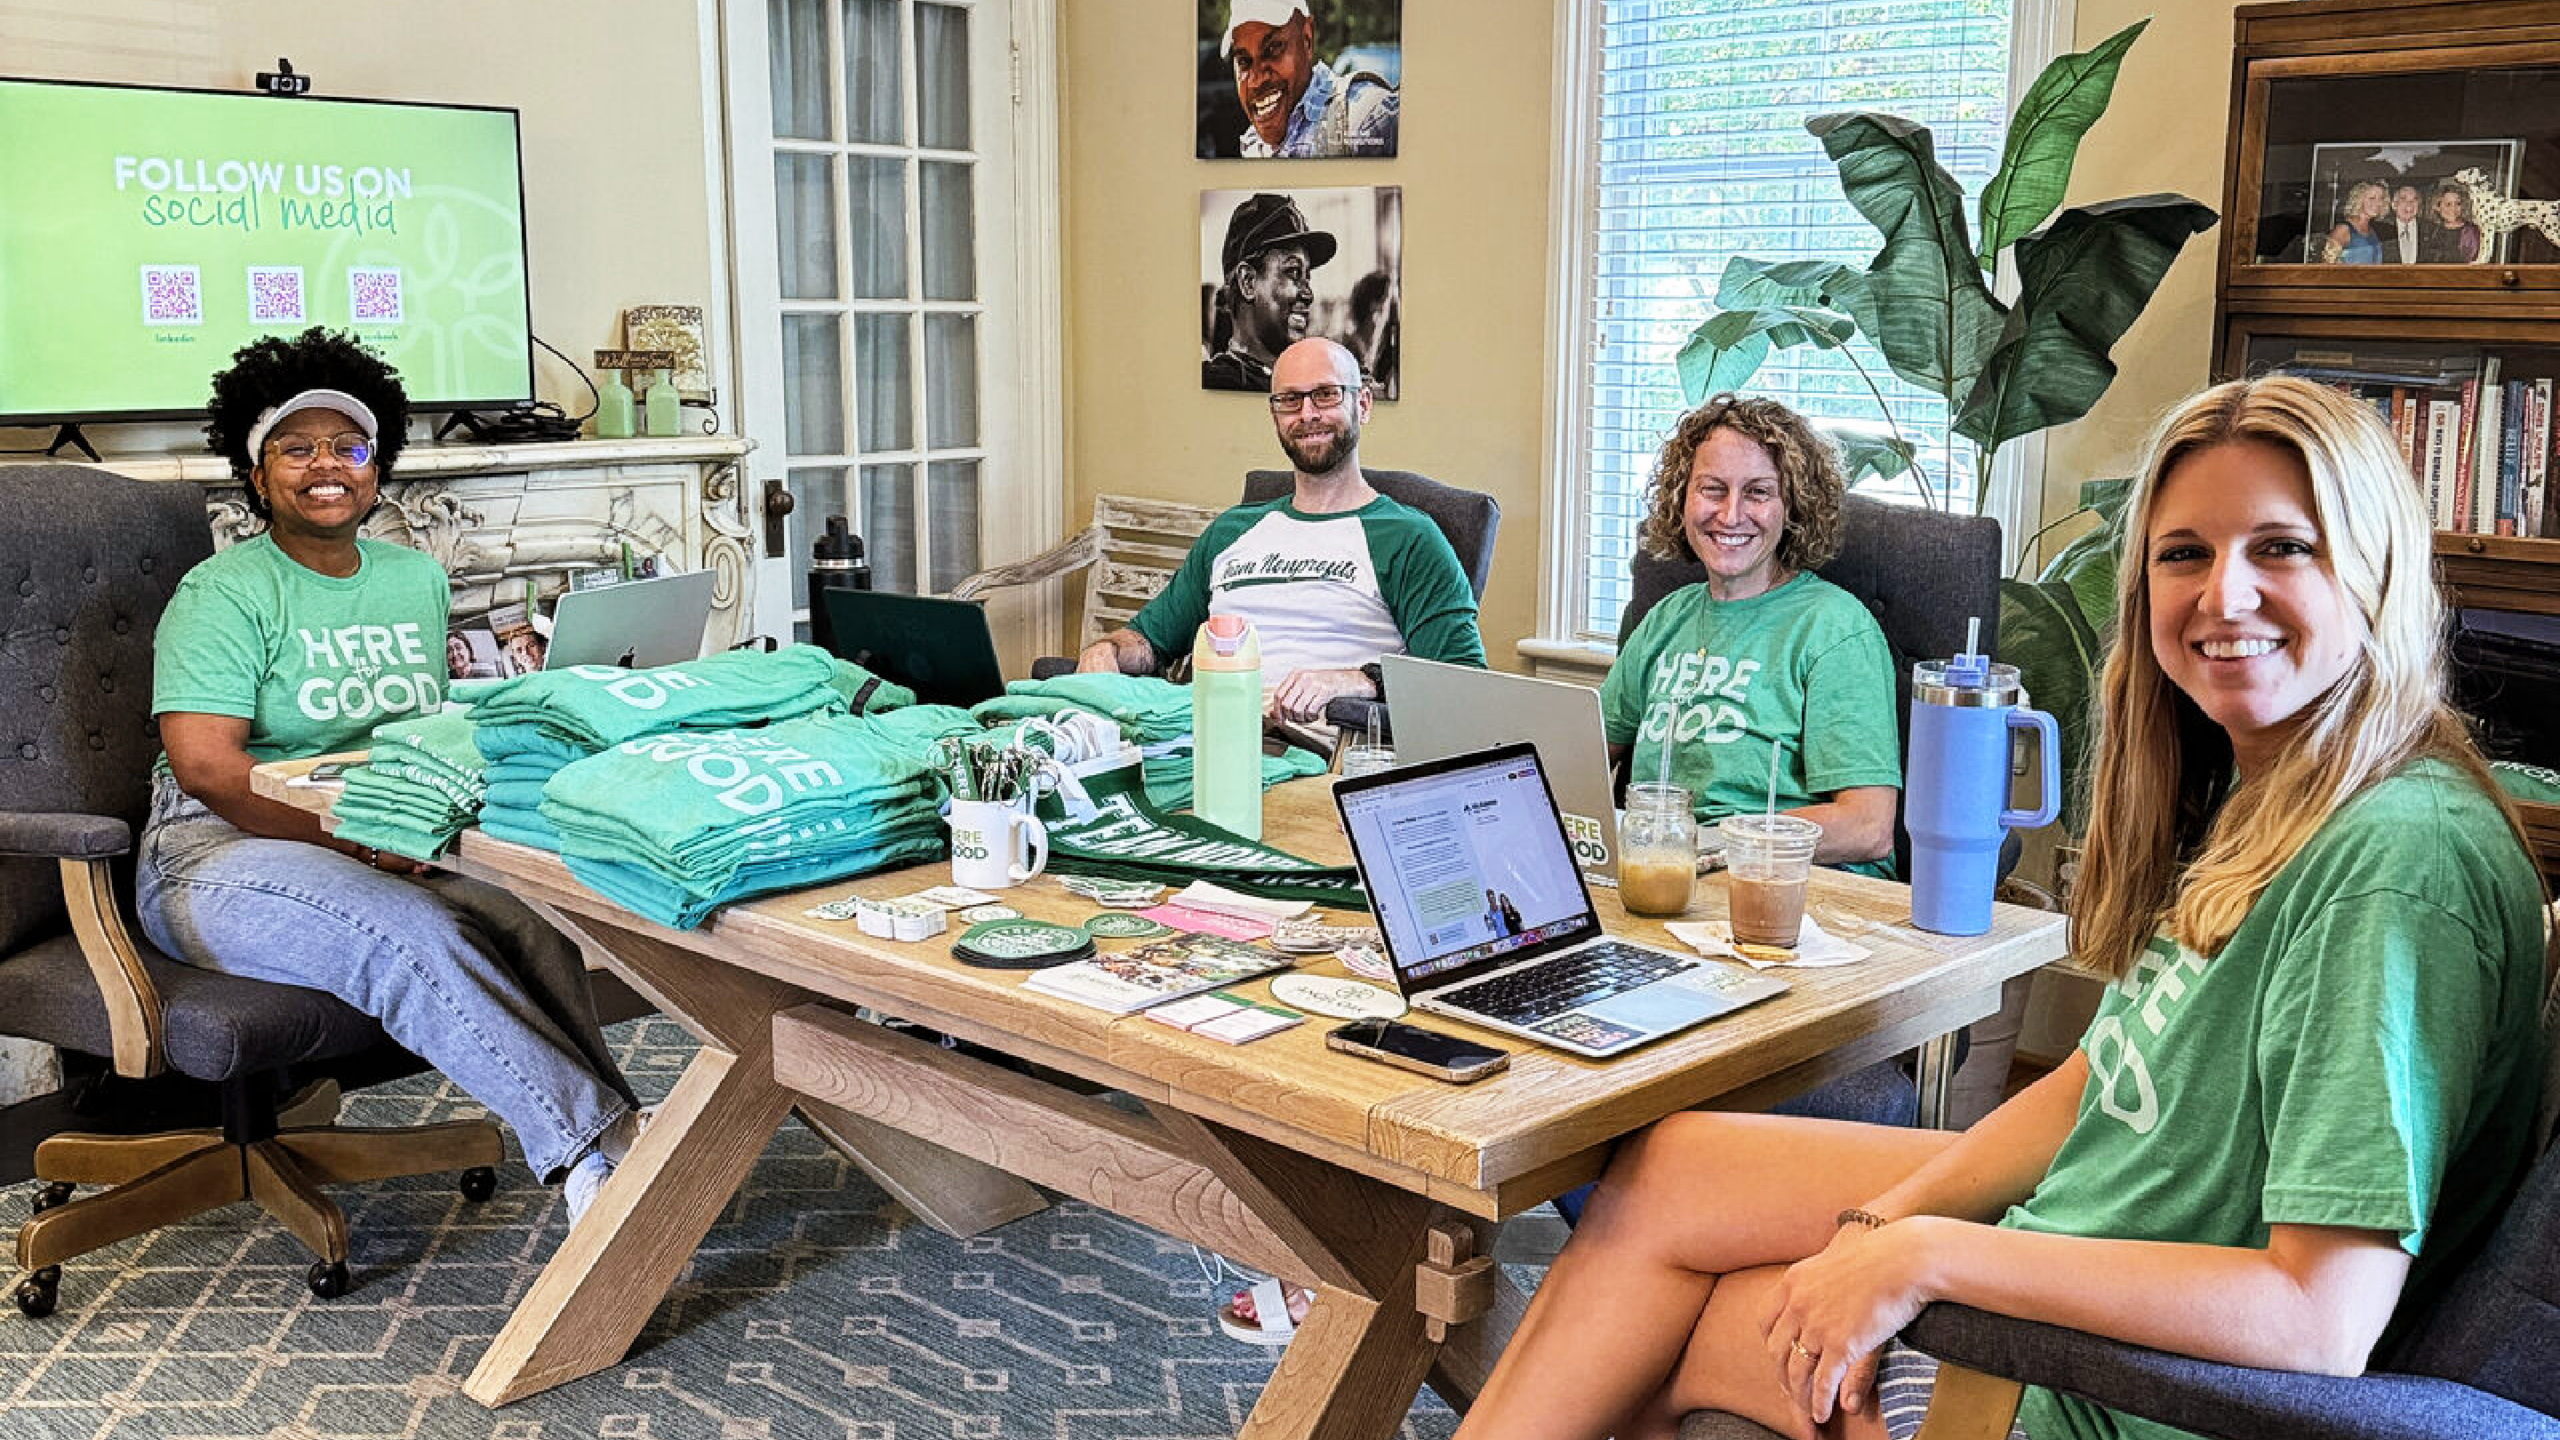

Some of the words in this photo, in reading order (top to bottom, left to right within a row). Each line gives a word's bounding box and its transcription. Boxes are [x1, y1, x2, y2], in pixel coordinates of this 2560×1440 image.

[114, 156, 286, 194] FOLLOW
[295, 164, 345, 198] US
[353, 165, 413, 199] ON
[143, 179, 261, 232] social
[280, 177, 397, 238] media
[297, 672, 443, 721] GOOD
[1650, 650, 1761, 704] HERE
